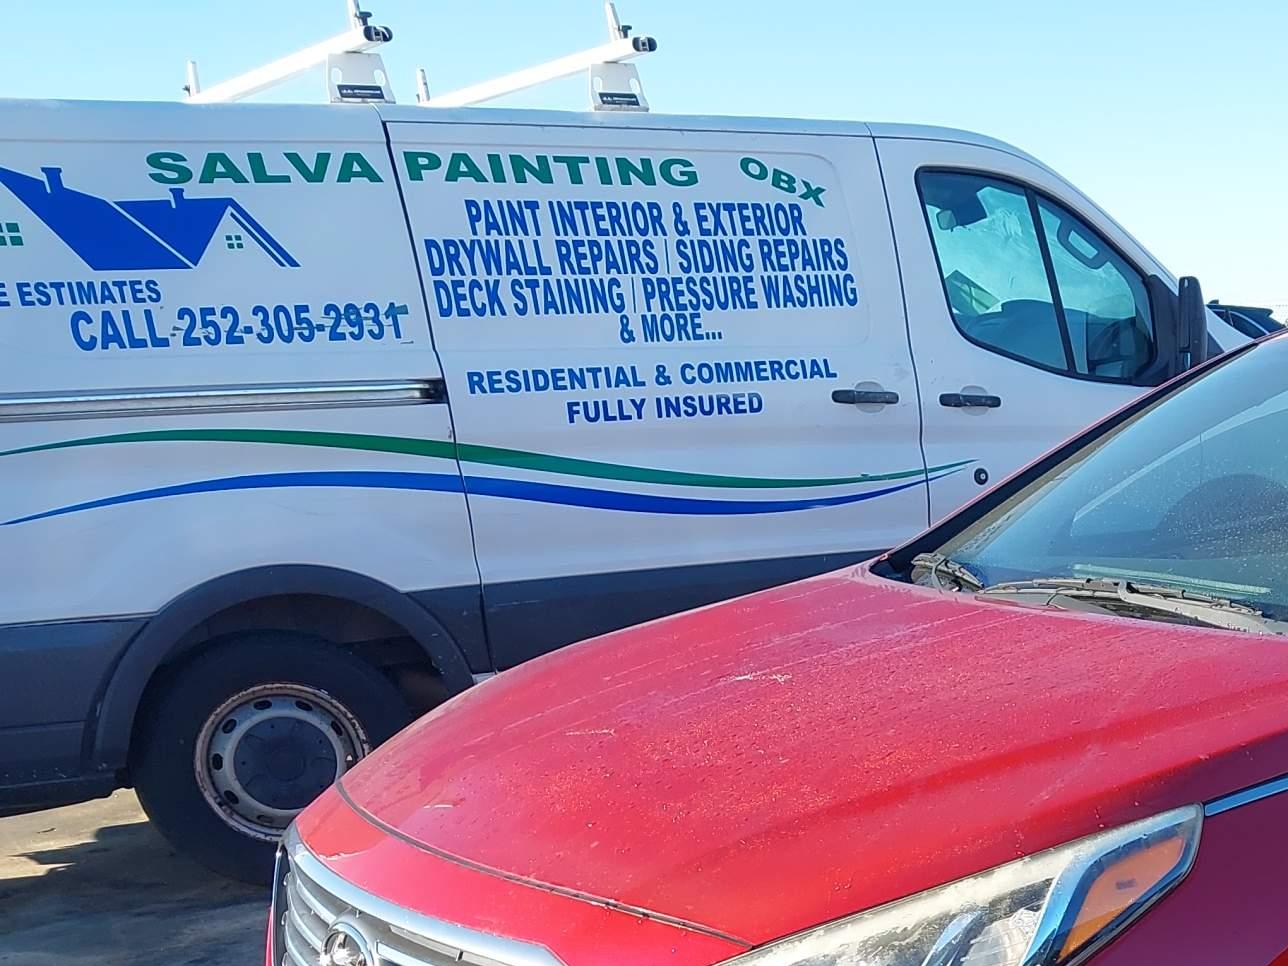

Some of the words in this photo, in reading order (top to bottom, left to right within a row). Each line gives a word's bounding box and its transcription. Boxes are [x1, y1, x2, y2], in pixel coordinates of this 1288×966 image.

[146, 152, 384, 184] SALVA
[403, 151, 699, 187] PAINTING
[739, 157, 826, 207] OBX
[464, 200, 541, 236] PAINT
[549, 201, 668, 237] INTERIOR
[672, 201, 691, 236] &
[693, 202, 808, 236] EXTERIOR
[424, 239, 551, 276] DRYWALL
[556, 238, 659, 275] REPAIRS
[675, 238, 755, 274] SIDING
[758, 238, 849, 272] REPAIRS
[16, 280, 161, 306] ESTIMATES
[433, 279, 507, 317] DECK
[511, 277, 625, 316] STAINING
[641, 275, 758, 313] PRESSURE
[760, 273, 858, 309] WASHING
[620, 314, 636, 344] &
[641, 313, 722, 343] MORE...
[466, 366, 646, 394] RESIDENTIAL
[655, 365, 672, 385] &
[680, 358, 838, 385] COMMERCIAL
[567, 398, 647, 424] FULLY
[655, 392, 763, 418] INSURED
